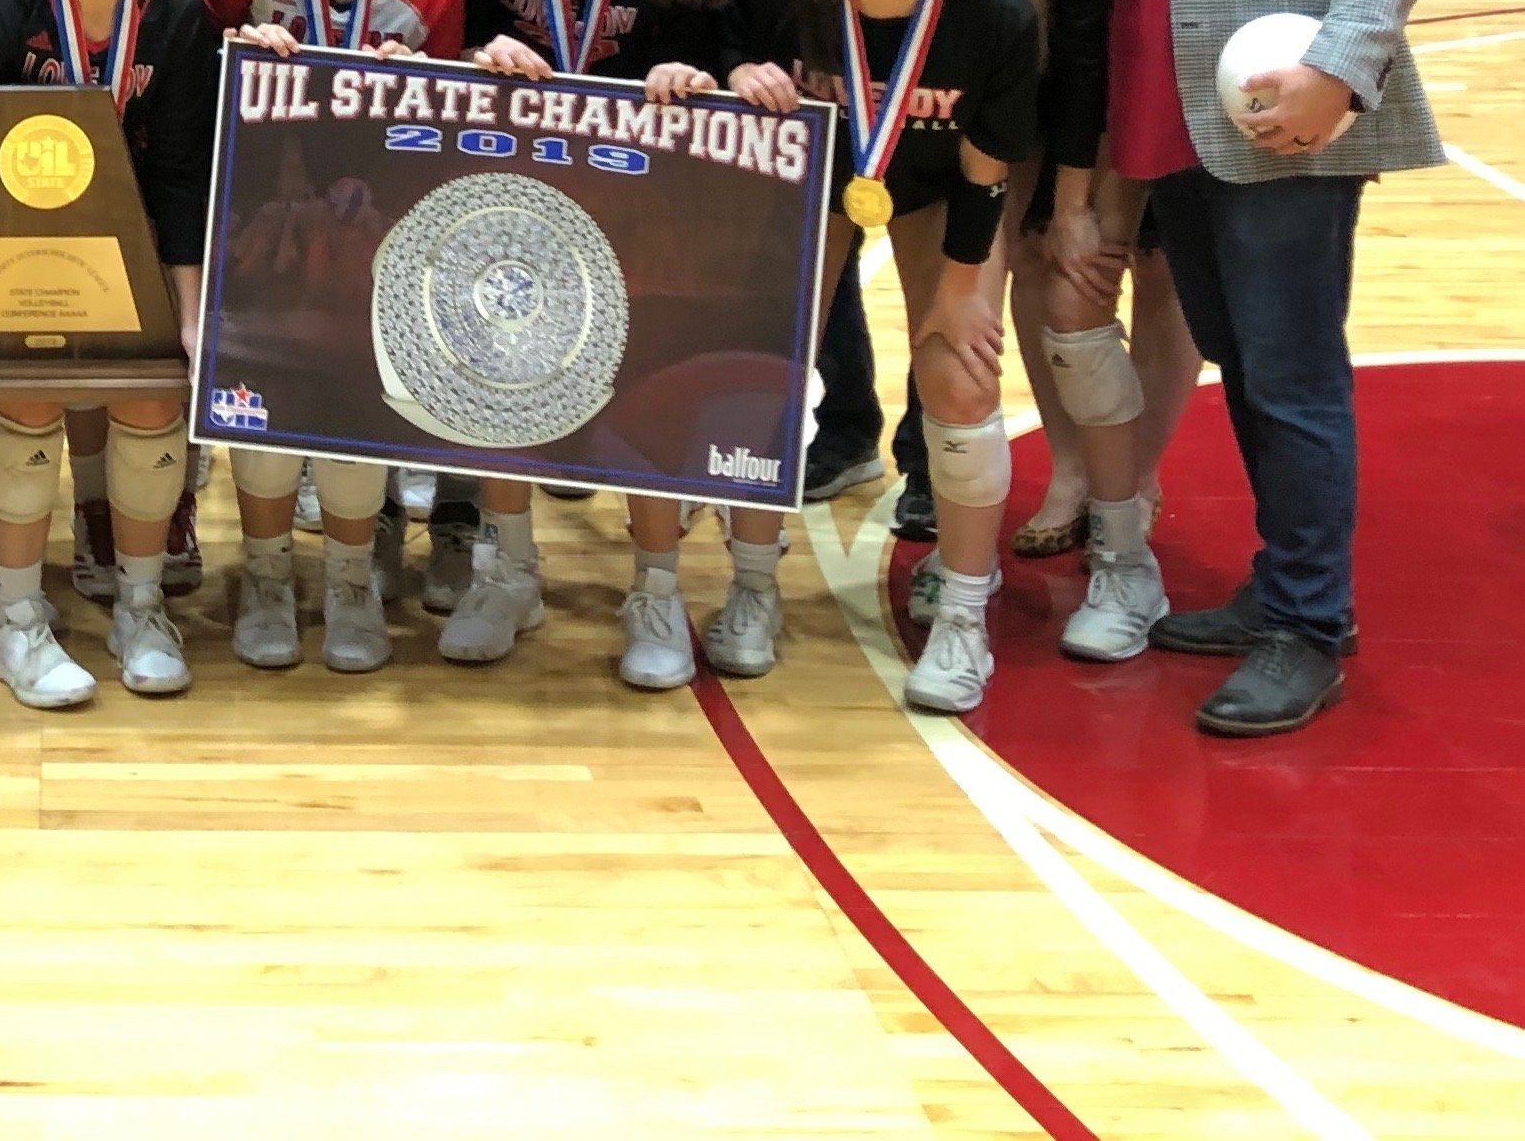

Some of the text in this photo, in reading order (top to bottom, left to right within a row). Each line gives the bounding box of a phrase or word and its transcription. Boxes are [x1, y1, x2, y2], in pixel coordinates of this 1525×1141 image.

[238, 59, 809, 184] UIL STATE CHAMPIONS
[385, 123, 651, 176] 2019
[707, 443, 782, 483] balfour
